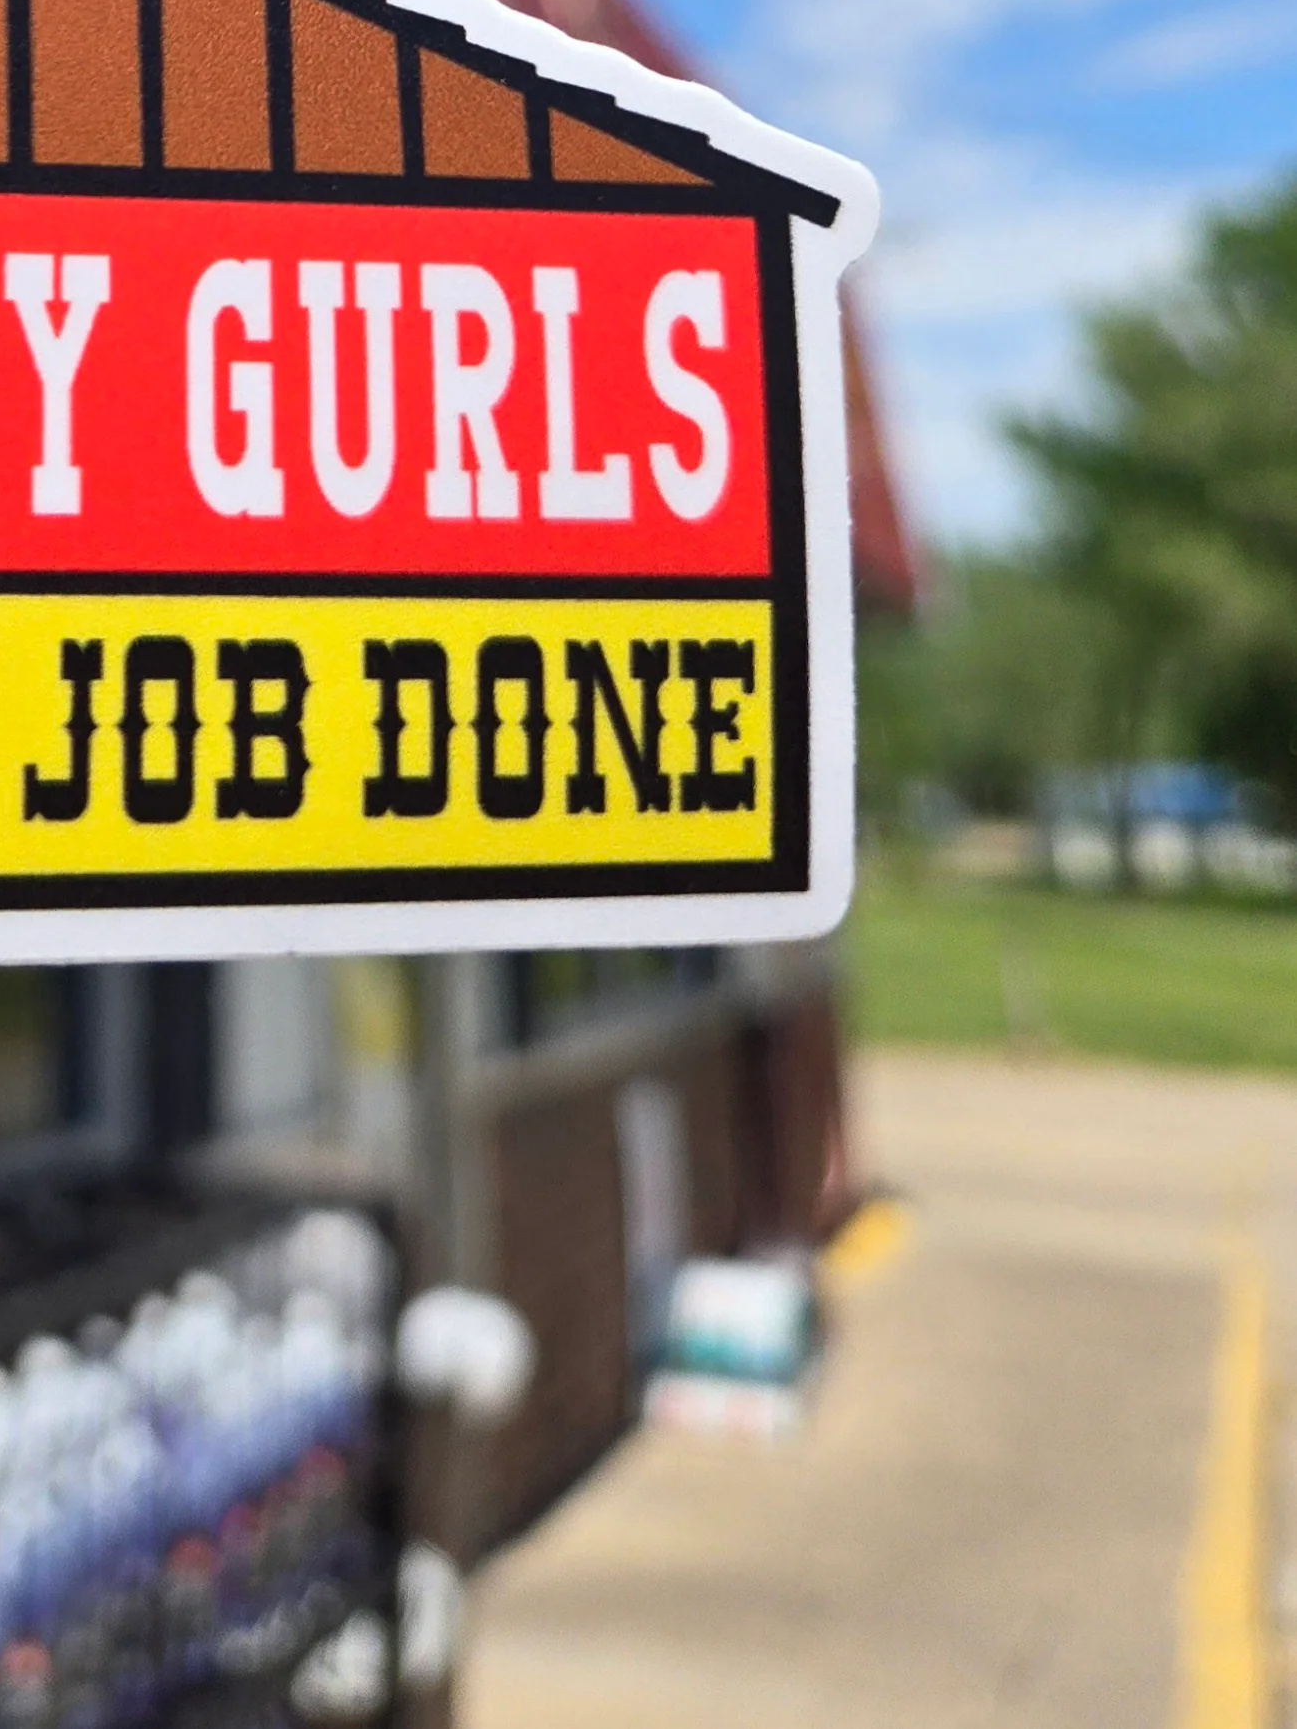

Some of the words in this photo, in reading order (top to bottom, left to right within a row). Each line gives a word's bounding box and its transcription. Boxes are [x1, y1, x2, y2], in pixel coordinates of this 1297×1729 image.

[185, 257, 732, 523] GURLS
[23, 634, 312, 825] JOB
[363, 634, 757, 820] DONE
